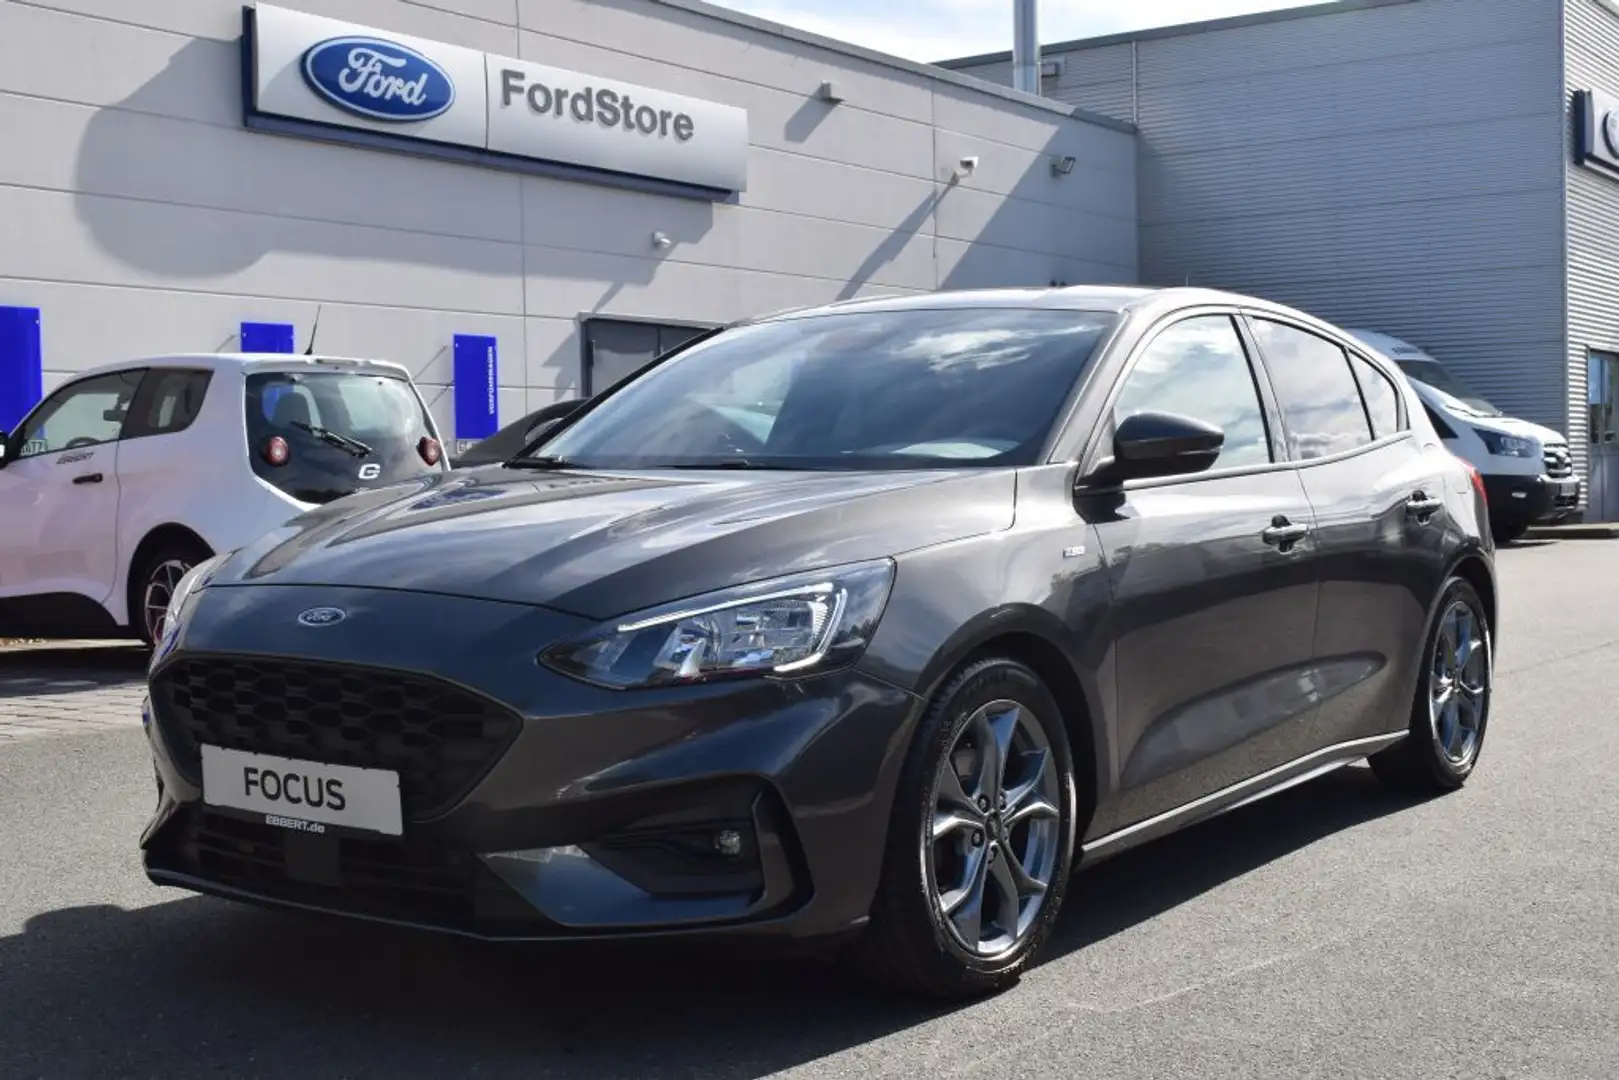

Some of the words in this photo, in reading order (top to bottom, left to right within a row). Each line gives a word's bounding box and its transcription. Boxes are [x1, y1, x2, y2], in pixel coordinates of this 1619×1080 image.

[338, 48, 428, 107] Ford
[500, 68, 695, 142] FordStore
[243, 766, 346, 811] FOCUS
[265, 814, 325, 834] EBBERT.de
